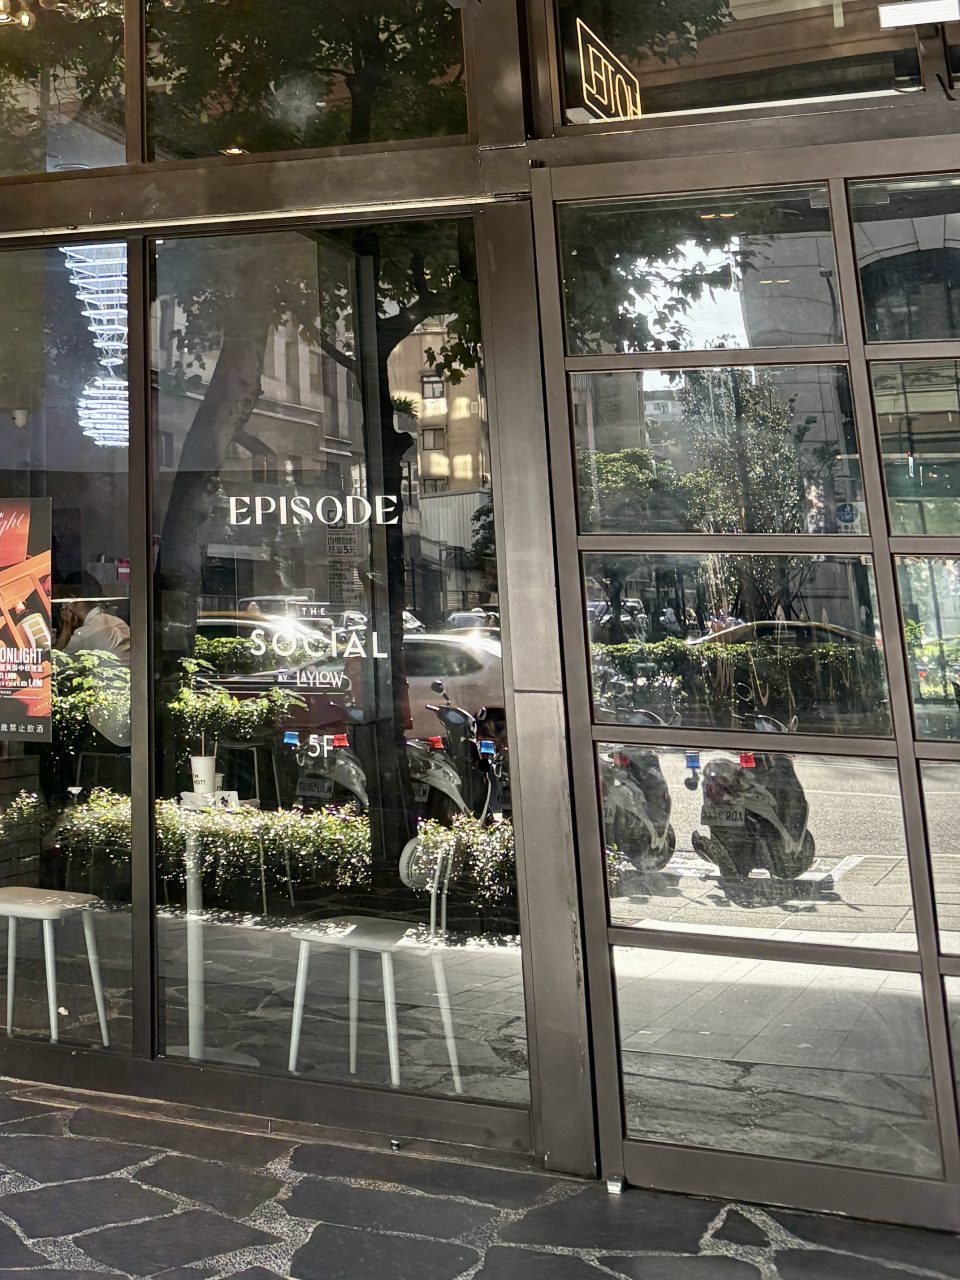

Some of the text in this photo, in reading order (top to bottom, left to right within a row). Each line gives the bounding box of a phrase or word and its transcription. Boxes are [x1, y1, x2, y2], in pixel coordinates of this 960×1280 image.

[229, 495, 399, 525] EPISODE
[301, 607, 326, 616] THE
[250, 628, 388, 659] SOCIAL
[295, 671, 344, 688] LAYLOW
[307, 733, 335, 758] 5F
